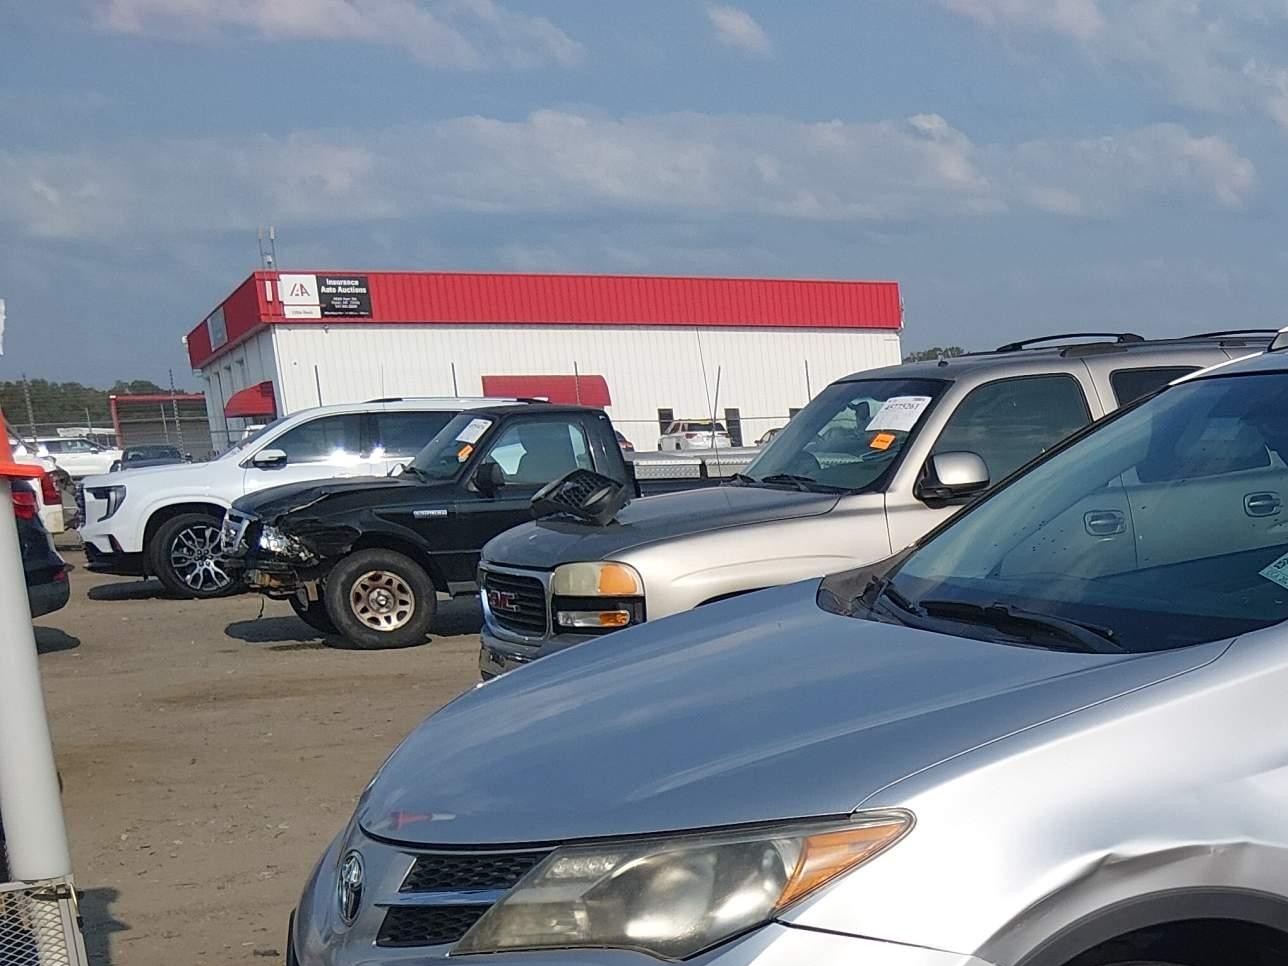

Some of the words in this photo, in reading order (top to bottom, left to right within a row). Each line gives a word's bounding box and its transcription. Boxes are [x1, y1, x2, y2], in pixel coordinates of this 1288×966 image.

[326, 278, 360, 286] Insurance
[320, 286, 337, 294] Auto
[337, 286, 367, 294] Auctions
